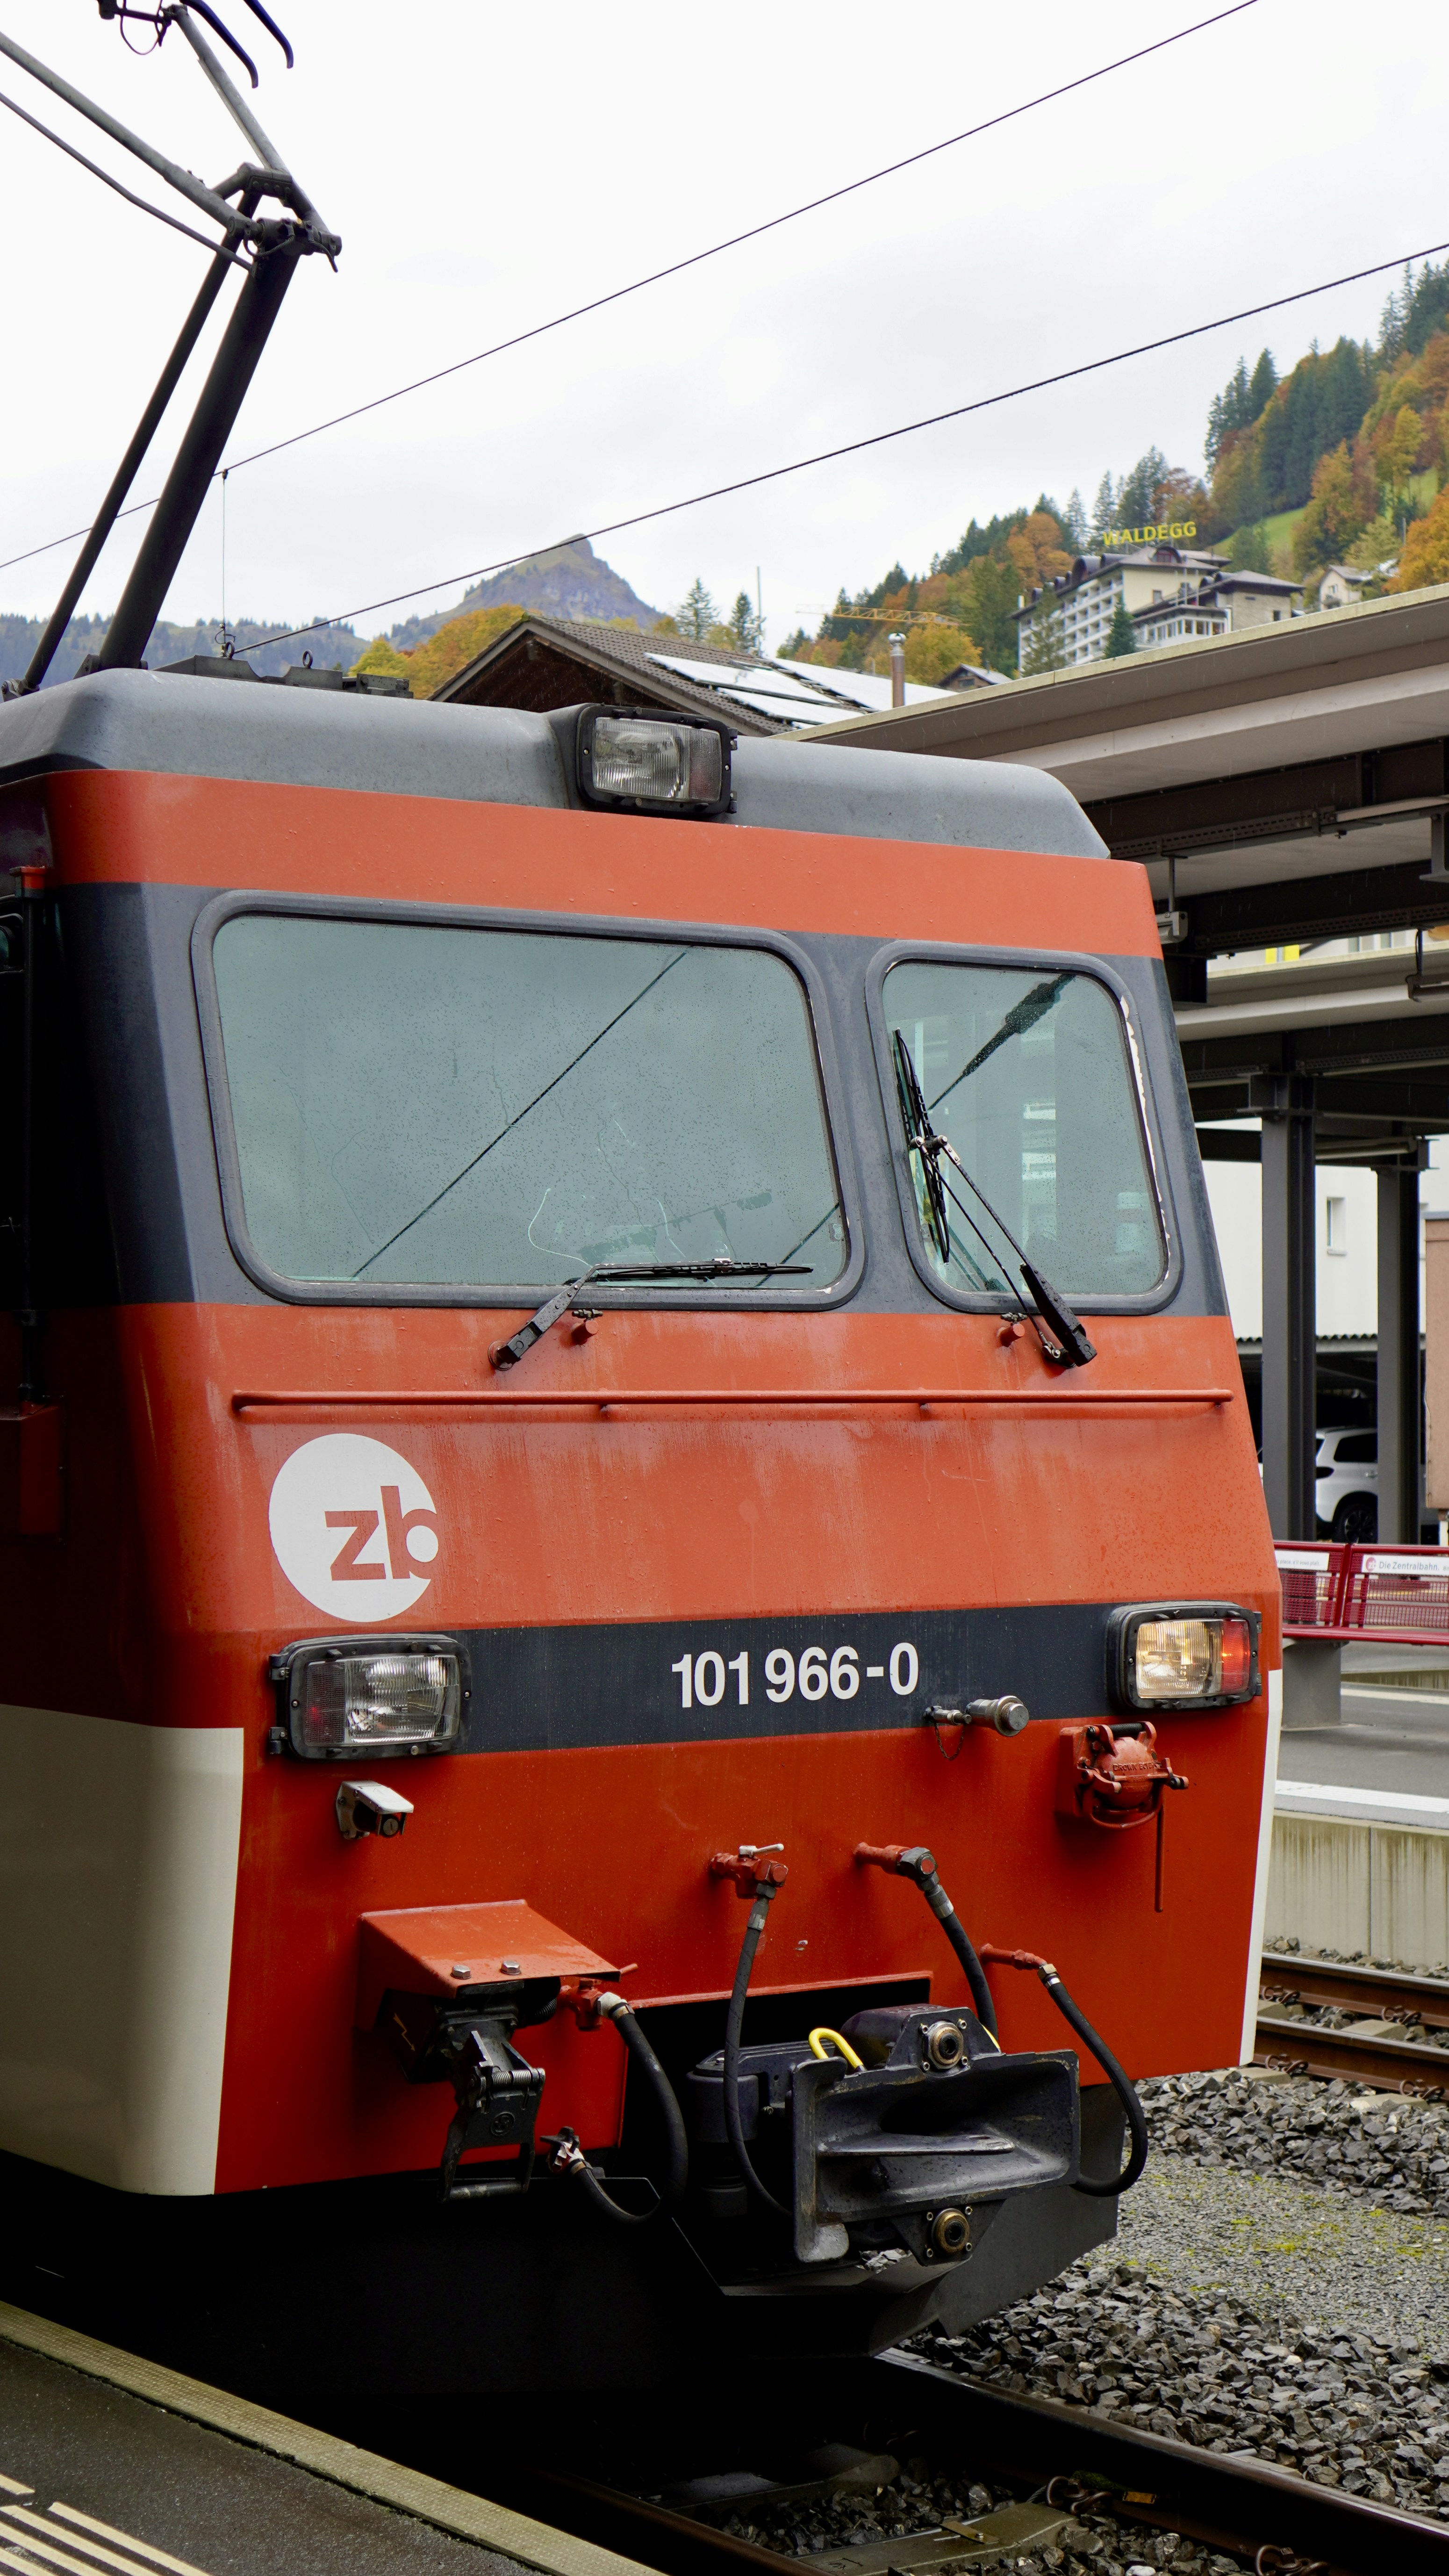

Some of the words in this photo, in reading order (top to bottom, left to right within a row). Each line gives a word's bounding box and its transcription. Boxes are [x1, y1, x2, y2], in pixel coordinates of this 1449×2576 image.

[1103, 521, 1197, 546] WALDEGG
[324, 1486, 441, 1581] zb
[1392, 1562, 1440, 1571] Zentralbahn.
[672, 1651, 748, 1708] 101
[765, 1642, 918, 1703] 966-0
[1113, 1763, 1137, 1771] BROWN
